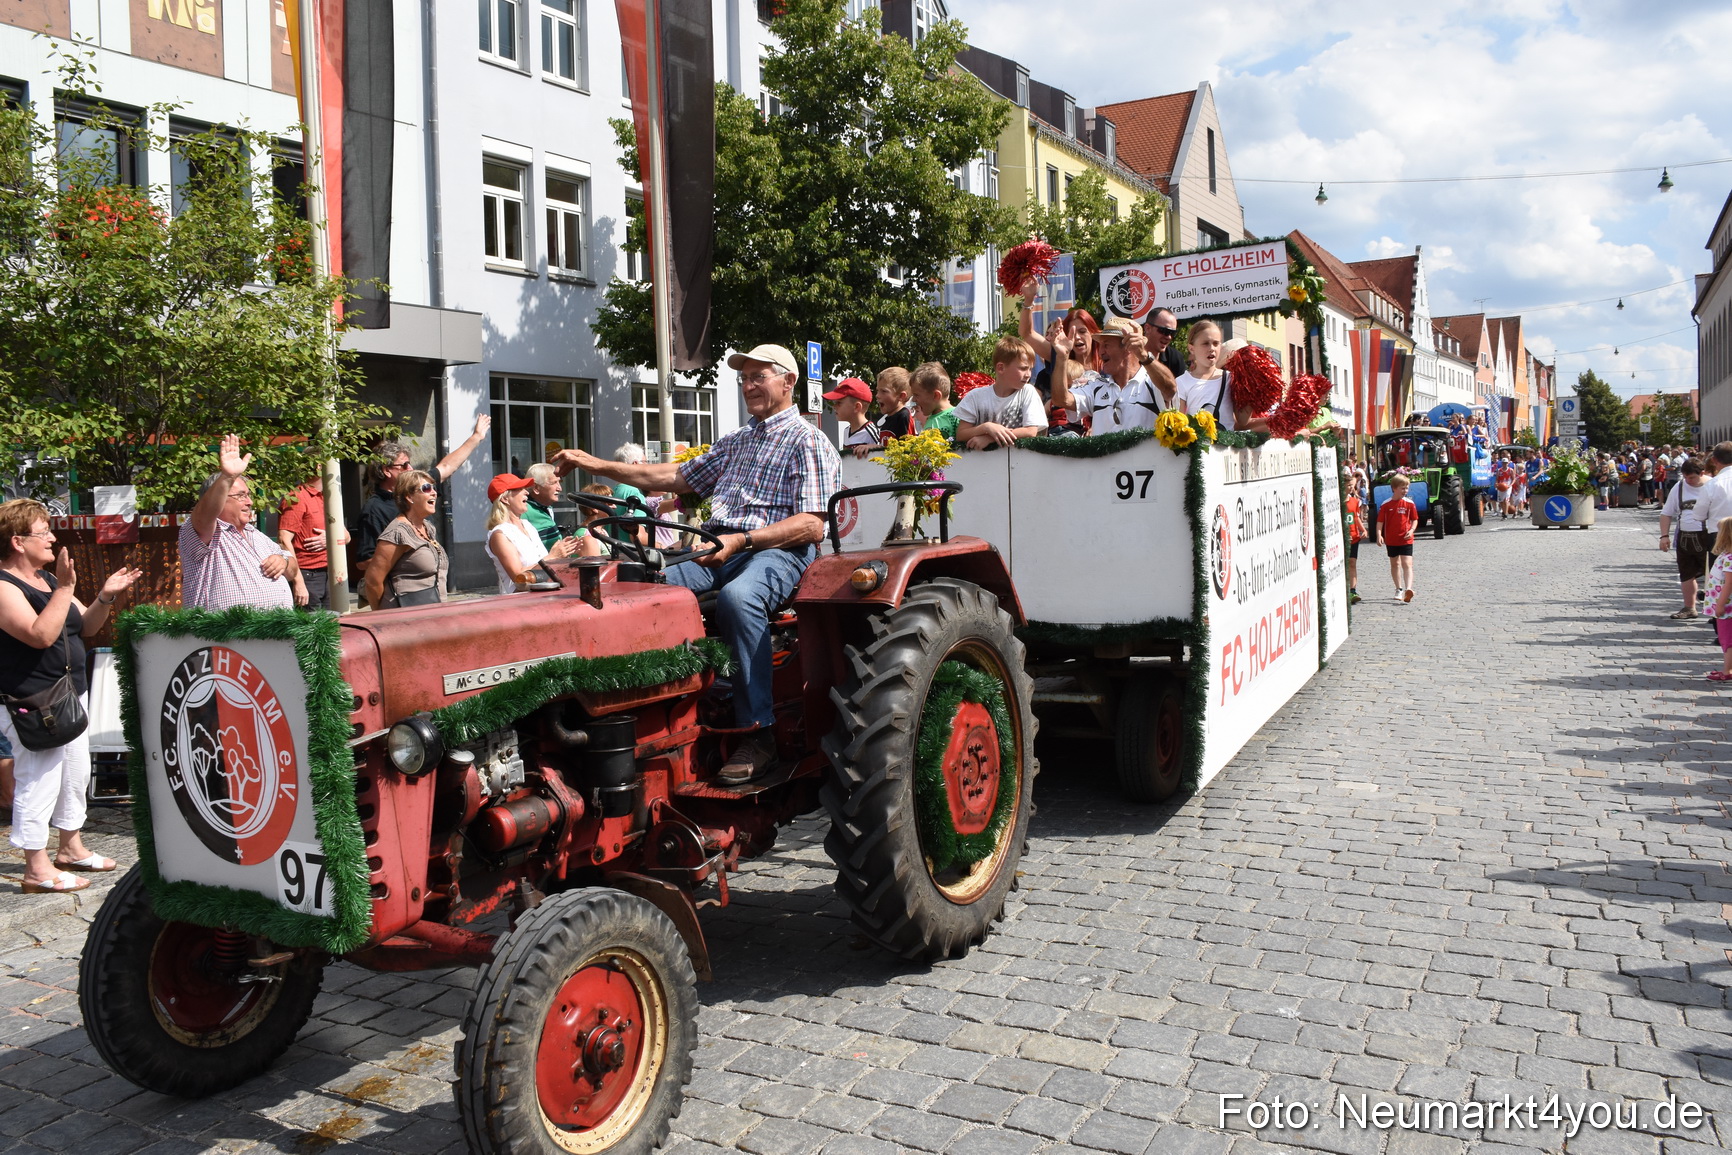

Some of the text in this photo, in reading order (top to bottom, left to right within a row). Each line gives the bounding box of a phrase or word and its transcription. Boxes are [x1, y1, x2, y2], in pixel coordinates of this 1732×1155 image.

[1164, 248, 1276, 278] FC HOLZHEIM
[1108, 270, 1151, 290] HOLZHEIM
[1165, 277, 1283, 300] Fußball, Tennis, Gymnastik,
[1167, 304, 1189, 314] Kraft
[1197, 300, 1231, 310] Fitness,
[1232, 293, 1281, 305] Kindertanz
[810, 346, 819, 375] P
[1115, 469, 1154, 500] 97
[1235, 497, 1254, 545] Am
[1221, 587, 1311, 707] FC HOLZHEIM
[163, 650, 283, 725] HOLZHEIM
[280, 848, 327, 910] 97
